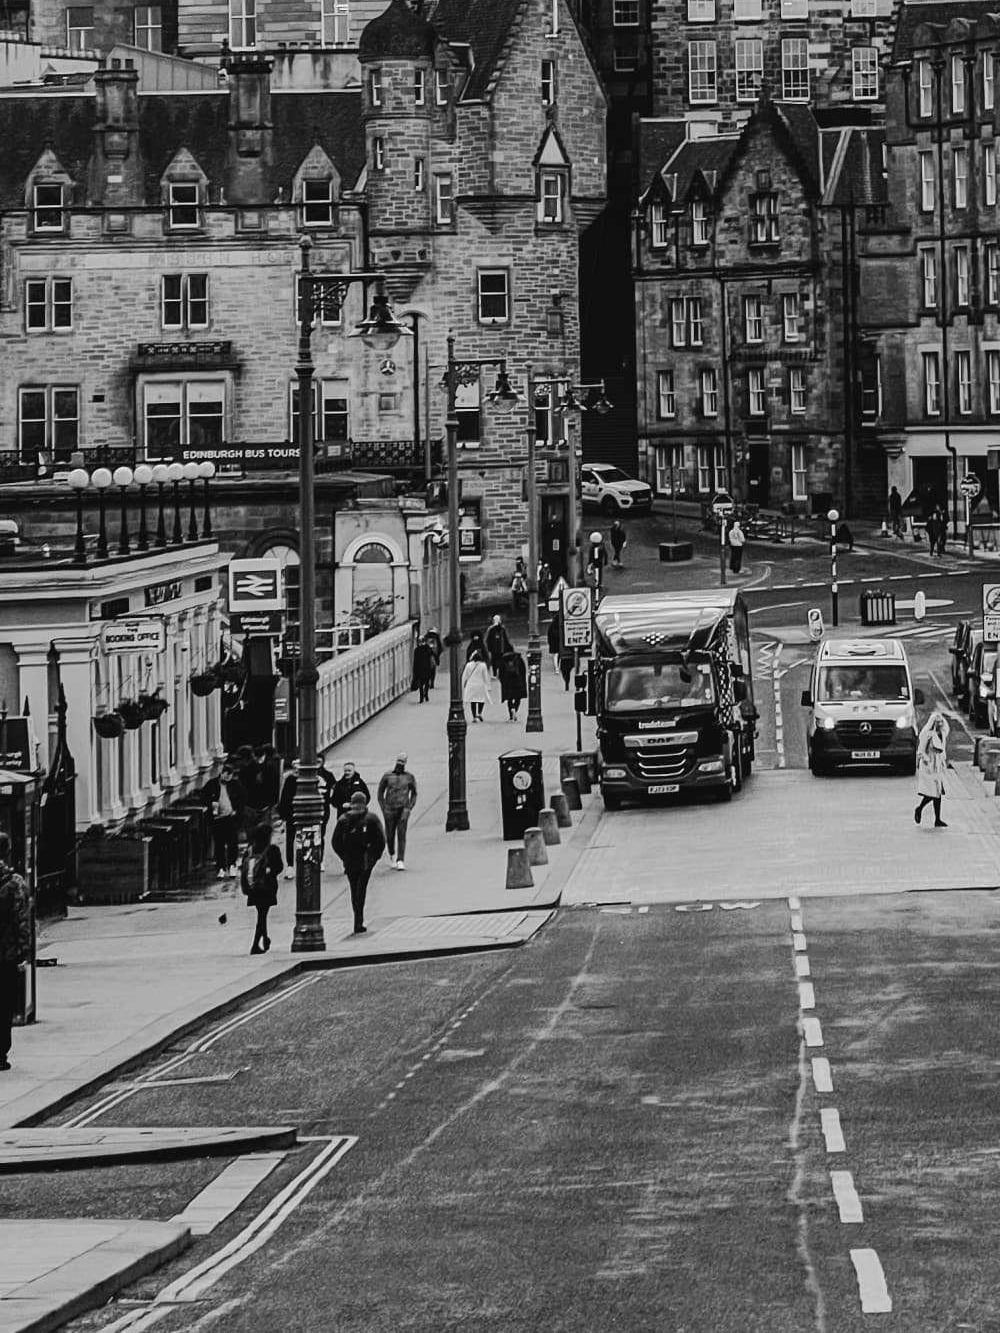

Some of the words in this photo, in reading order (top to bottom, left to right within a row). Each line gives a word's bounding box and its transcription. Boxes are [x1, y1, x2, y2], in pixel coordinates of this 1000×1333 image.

[183, 449, 243, 459] EDINBURGH
[245, 449, 265, 458] BUS
[267, 448, 301, 457] TOURS
[105, 633, 135, 643] BOOKING
[137, 632, 160, 642] OFFICE
